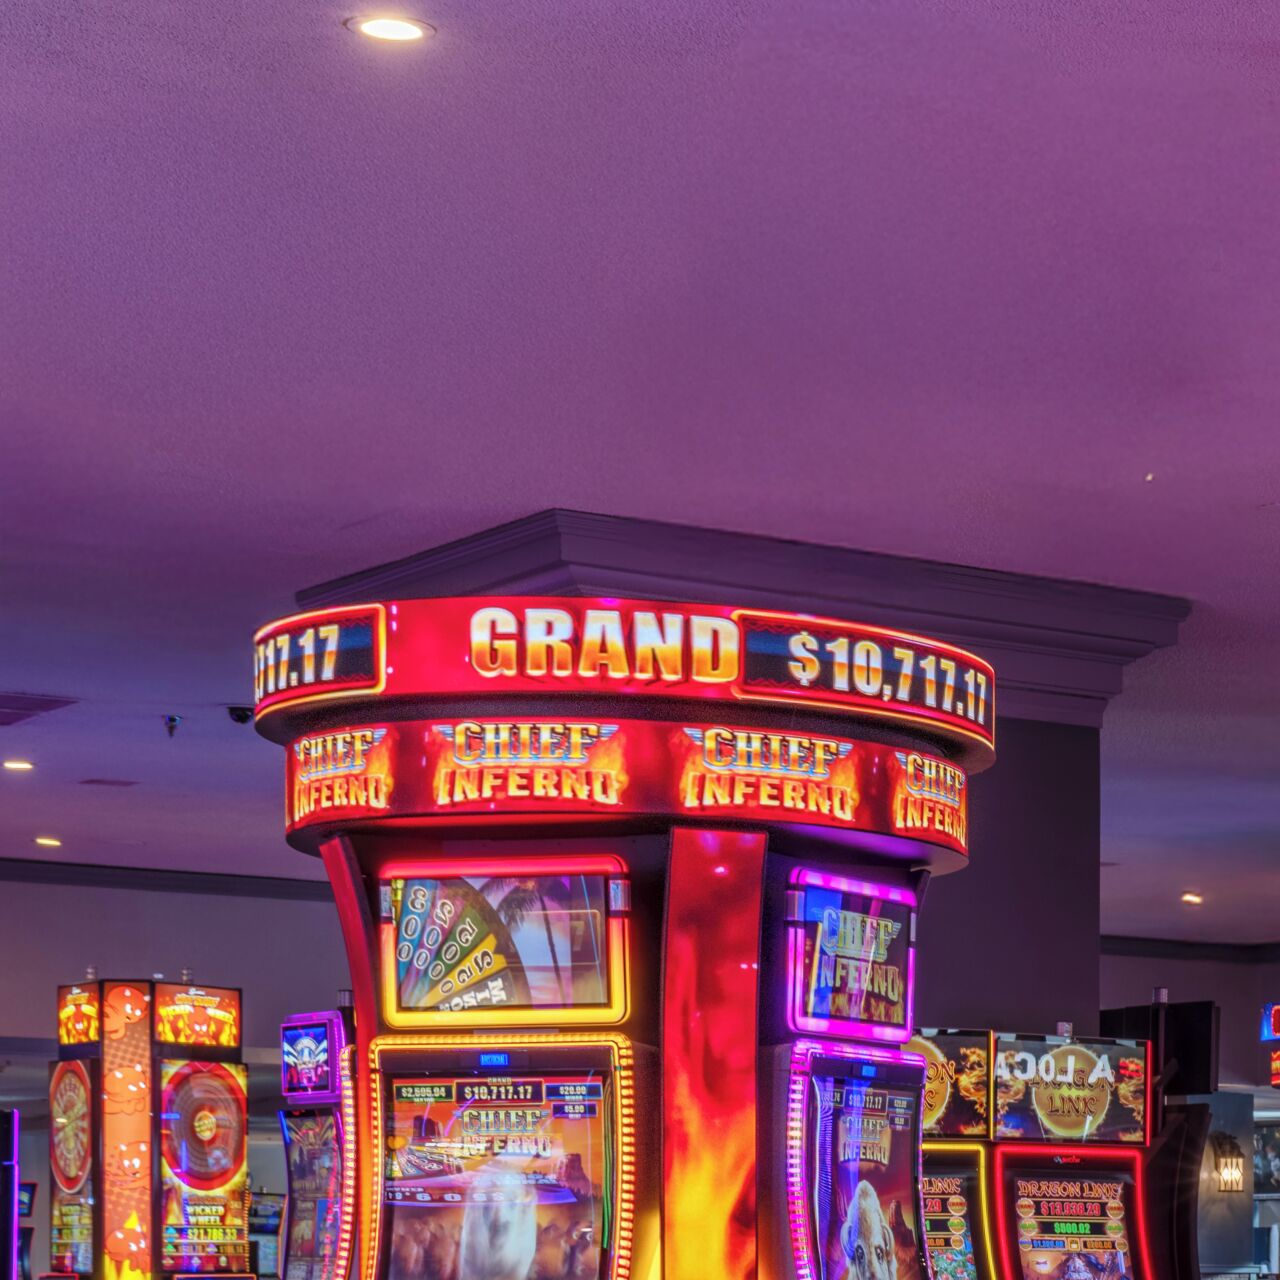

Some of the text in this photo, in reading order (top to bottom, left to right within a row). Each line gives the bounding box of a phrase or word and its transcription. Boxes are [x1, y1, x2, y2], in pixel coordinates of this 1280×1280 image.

[470, 606, 740, 683] GRAND
[788, 631, 987, 725] $10,717.17
[299, 729, 376, 779] CHIEF
[453, 722, 600, 767] CHIEF
[703, 727, 839, 778] CHIEF
[294, 774, 390, 822] INFERNO
[437, 768, 622, 806] INFERNO
[684, 772, 855, 821] INFERNO
[906, 752, 965, 805] CHIEF
[821, 907, 893, 960] CHIEF
[464, 1086, 532, 1100] $10,717.17
[1047, 1096, 1097, 1116] LINK
[461, 1109, 542, 1133] CHIEF
[1018, 1180, 1081, 1197] DRAGON
